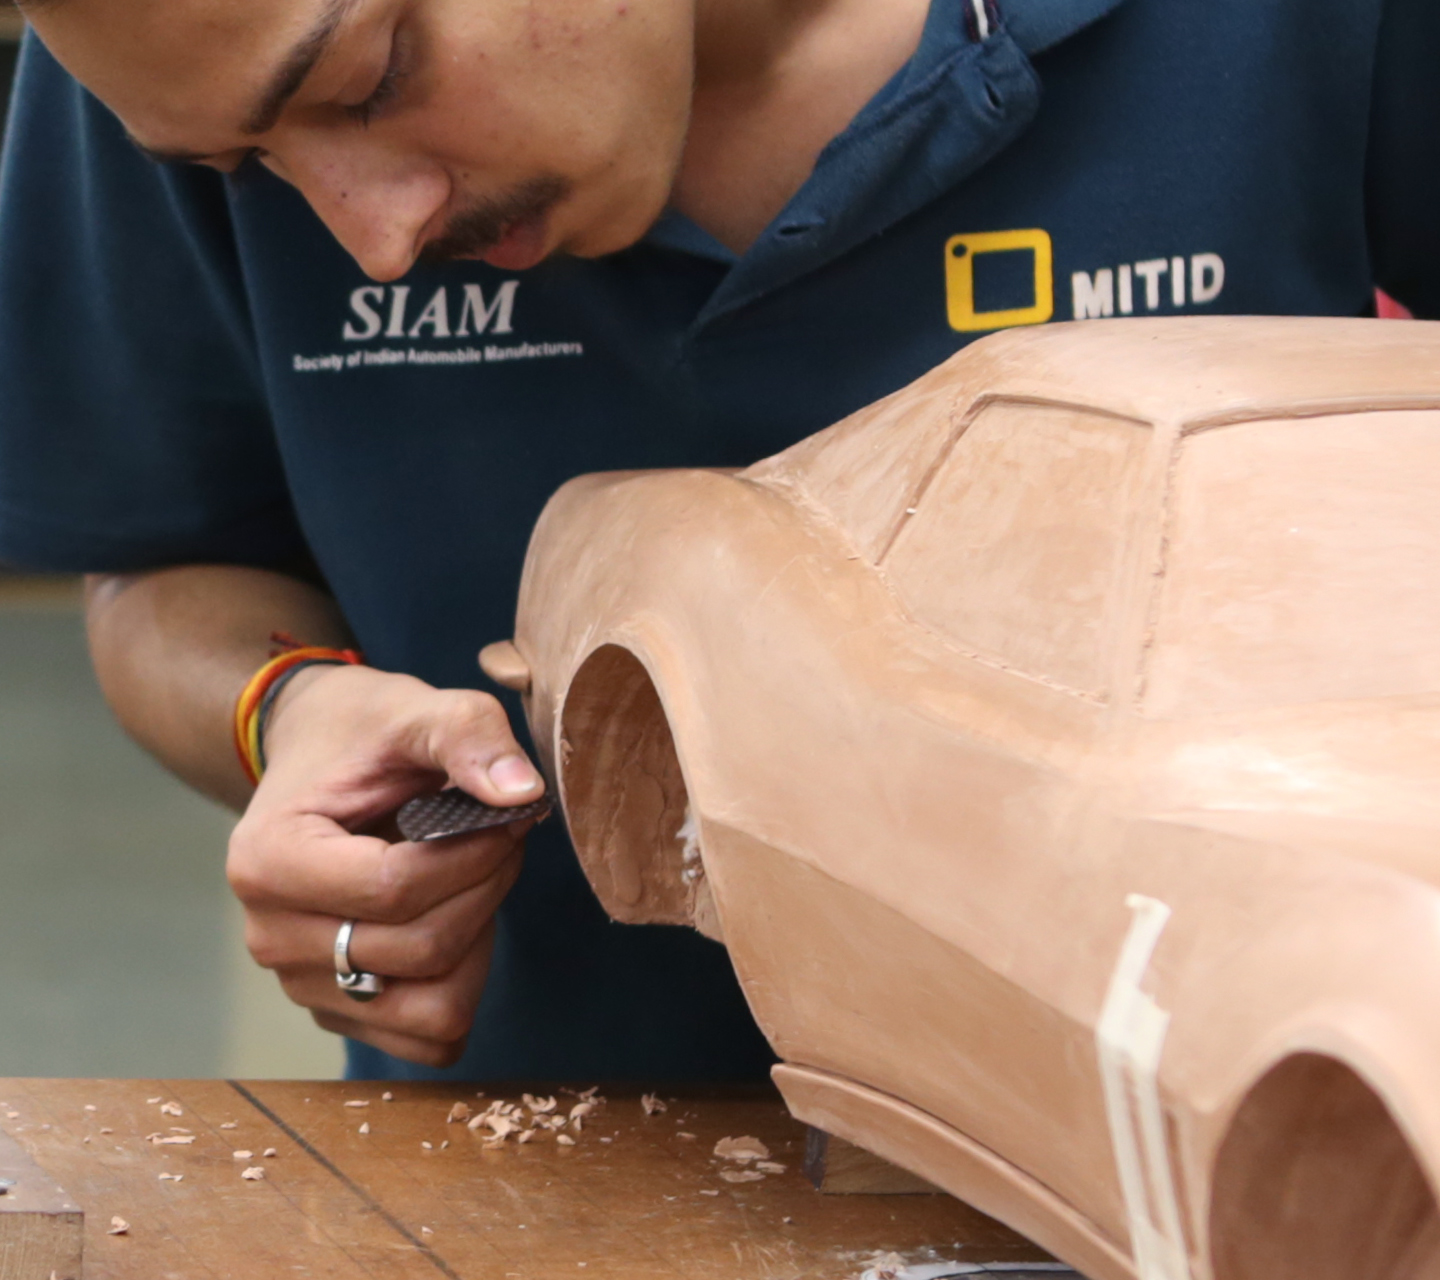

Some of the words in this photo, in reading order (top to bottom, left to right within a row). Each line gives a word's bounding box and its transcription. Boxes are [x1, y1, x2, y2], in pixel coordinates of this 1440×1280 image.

[342, 280, 520, 341] SIAM
[1071, 252, 1225, 320] MITID
[293, 353, 343, 371] Society
[346, 350, 362, 368] of
[364, 348, 405, 365] Indian
[407, 345, 481, 365] Automobile
[484, 341, 583, 362] Manufacturers
